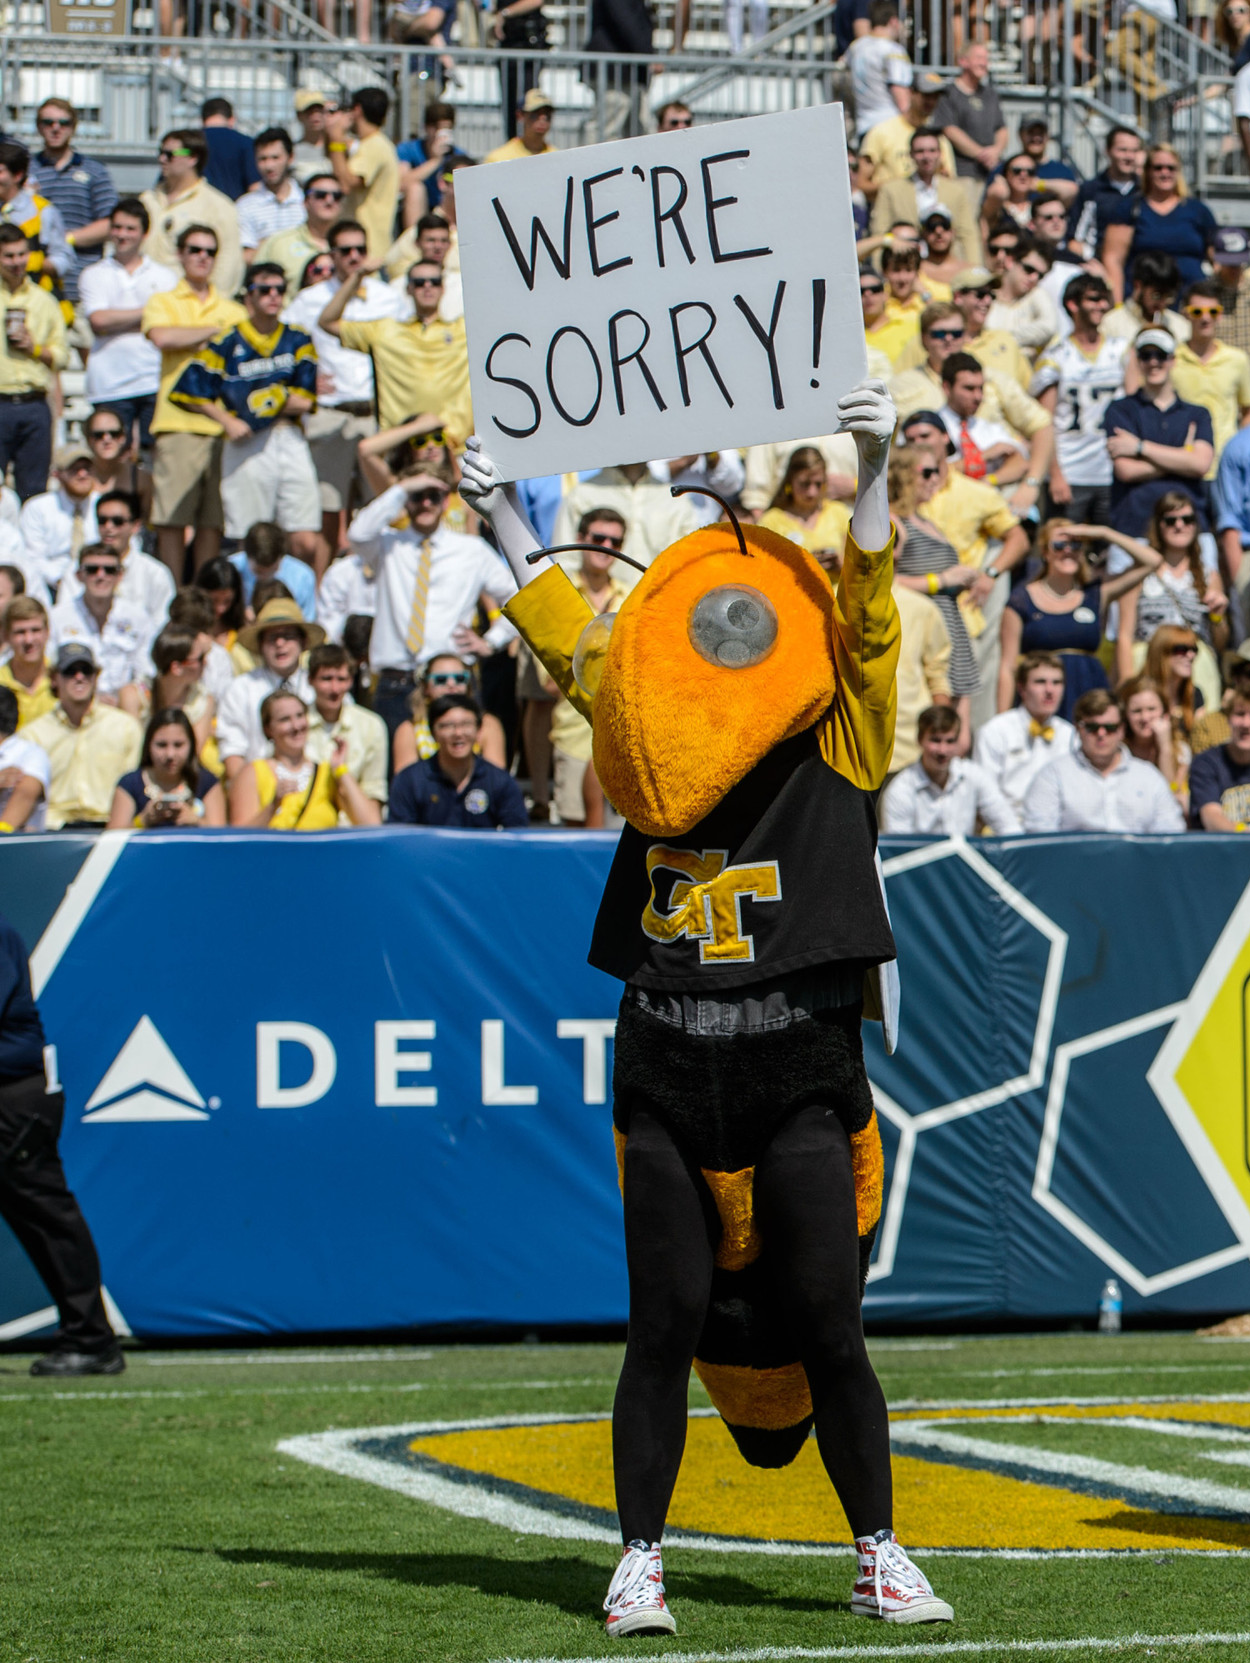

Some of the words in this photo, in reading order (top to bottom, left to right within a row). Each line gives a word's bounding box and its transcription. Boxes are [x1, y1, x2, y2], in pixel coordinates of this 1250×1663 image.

[490, 148, 775, 293] WE'RE
[484, 277, 827, 440] SORRY!
[641, 843, 782, 965] GT
[256, 1018, 618, 1108] DELT
